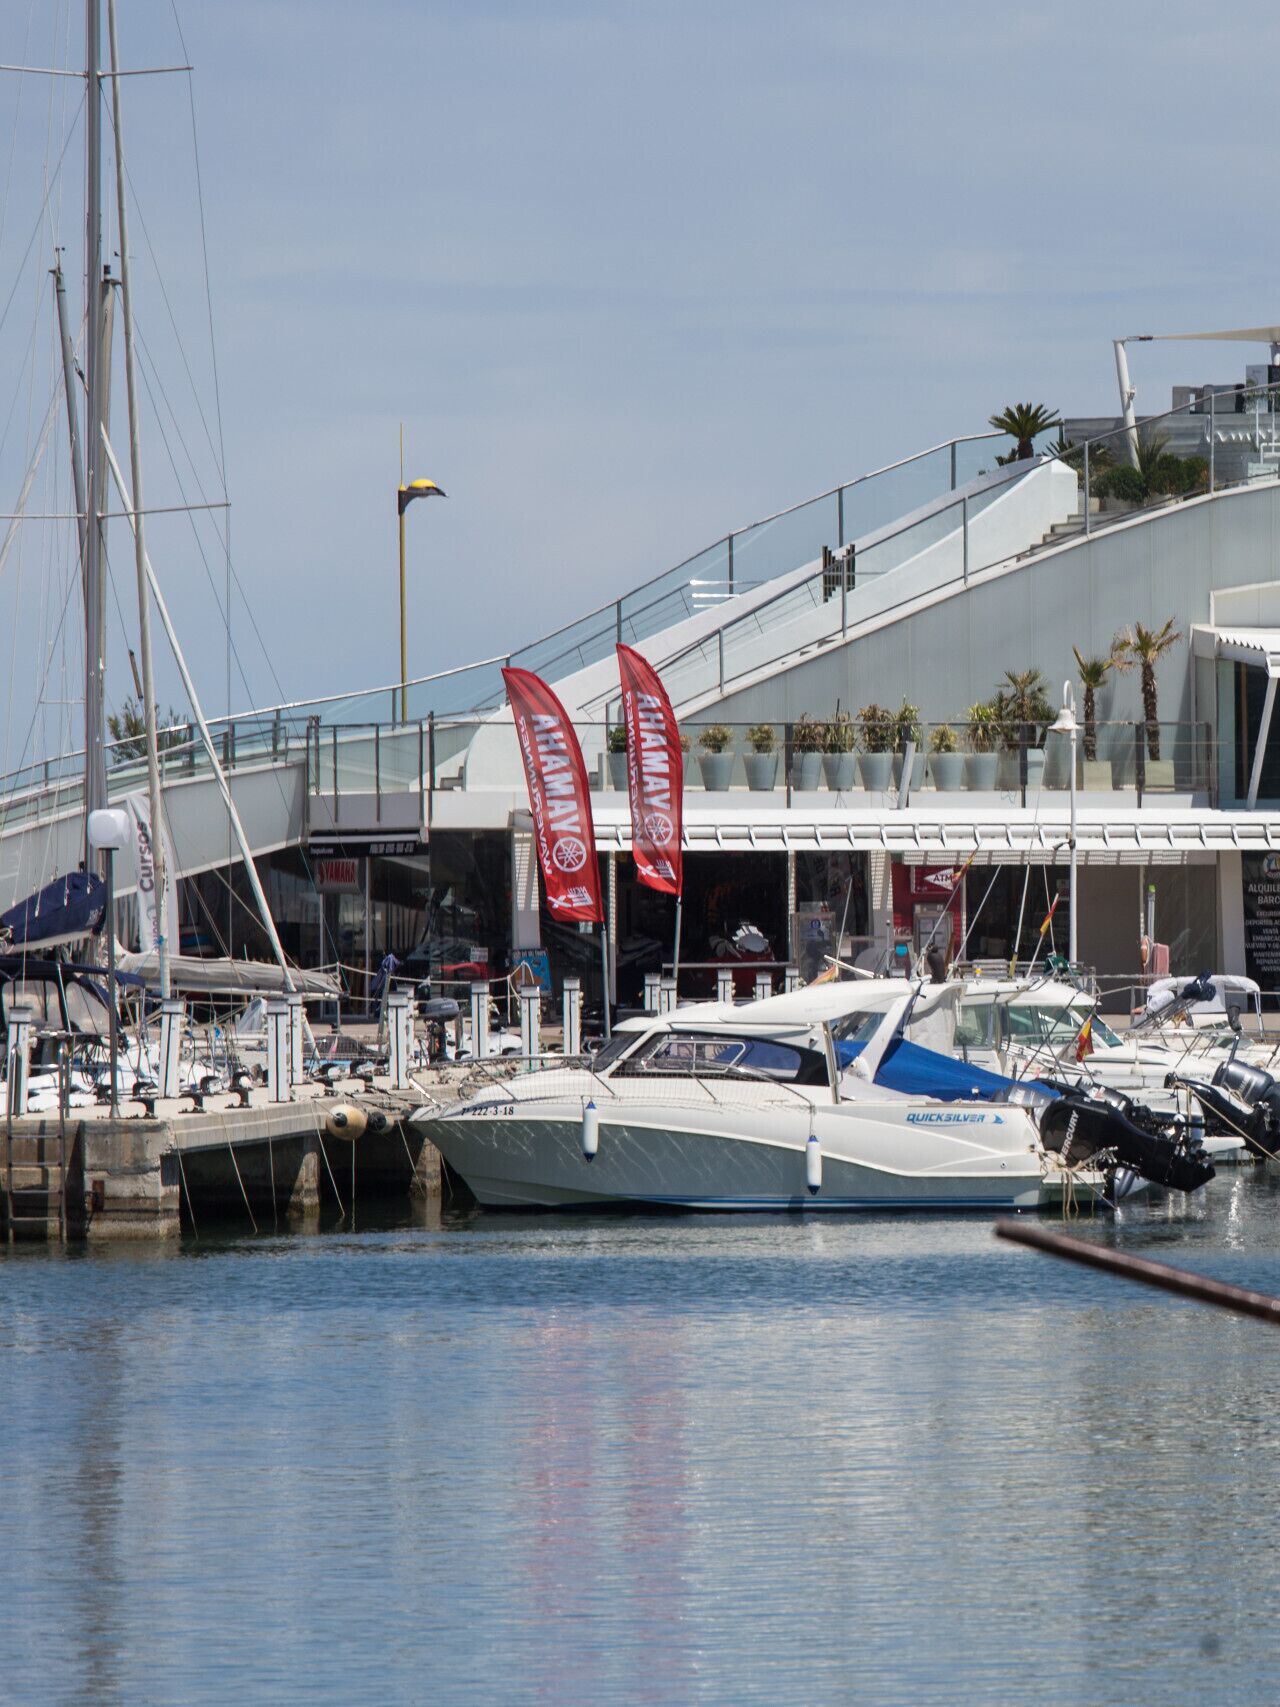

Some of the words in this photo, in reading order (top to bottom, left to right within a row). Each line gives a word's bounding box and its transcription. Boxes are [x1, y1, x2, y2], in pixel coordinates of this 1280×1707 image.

[139, 821, 154, 892] Cursos
[325, 861, 356, 883] YAMAHA
[933, 874, 953, 882] ATM
[472, 1106, 514, 1116] 222-3-18
[906, 1112, 986, 1125] QUICKSILVER
